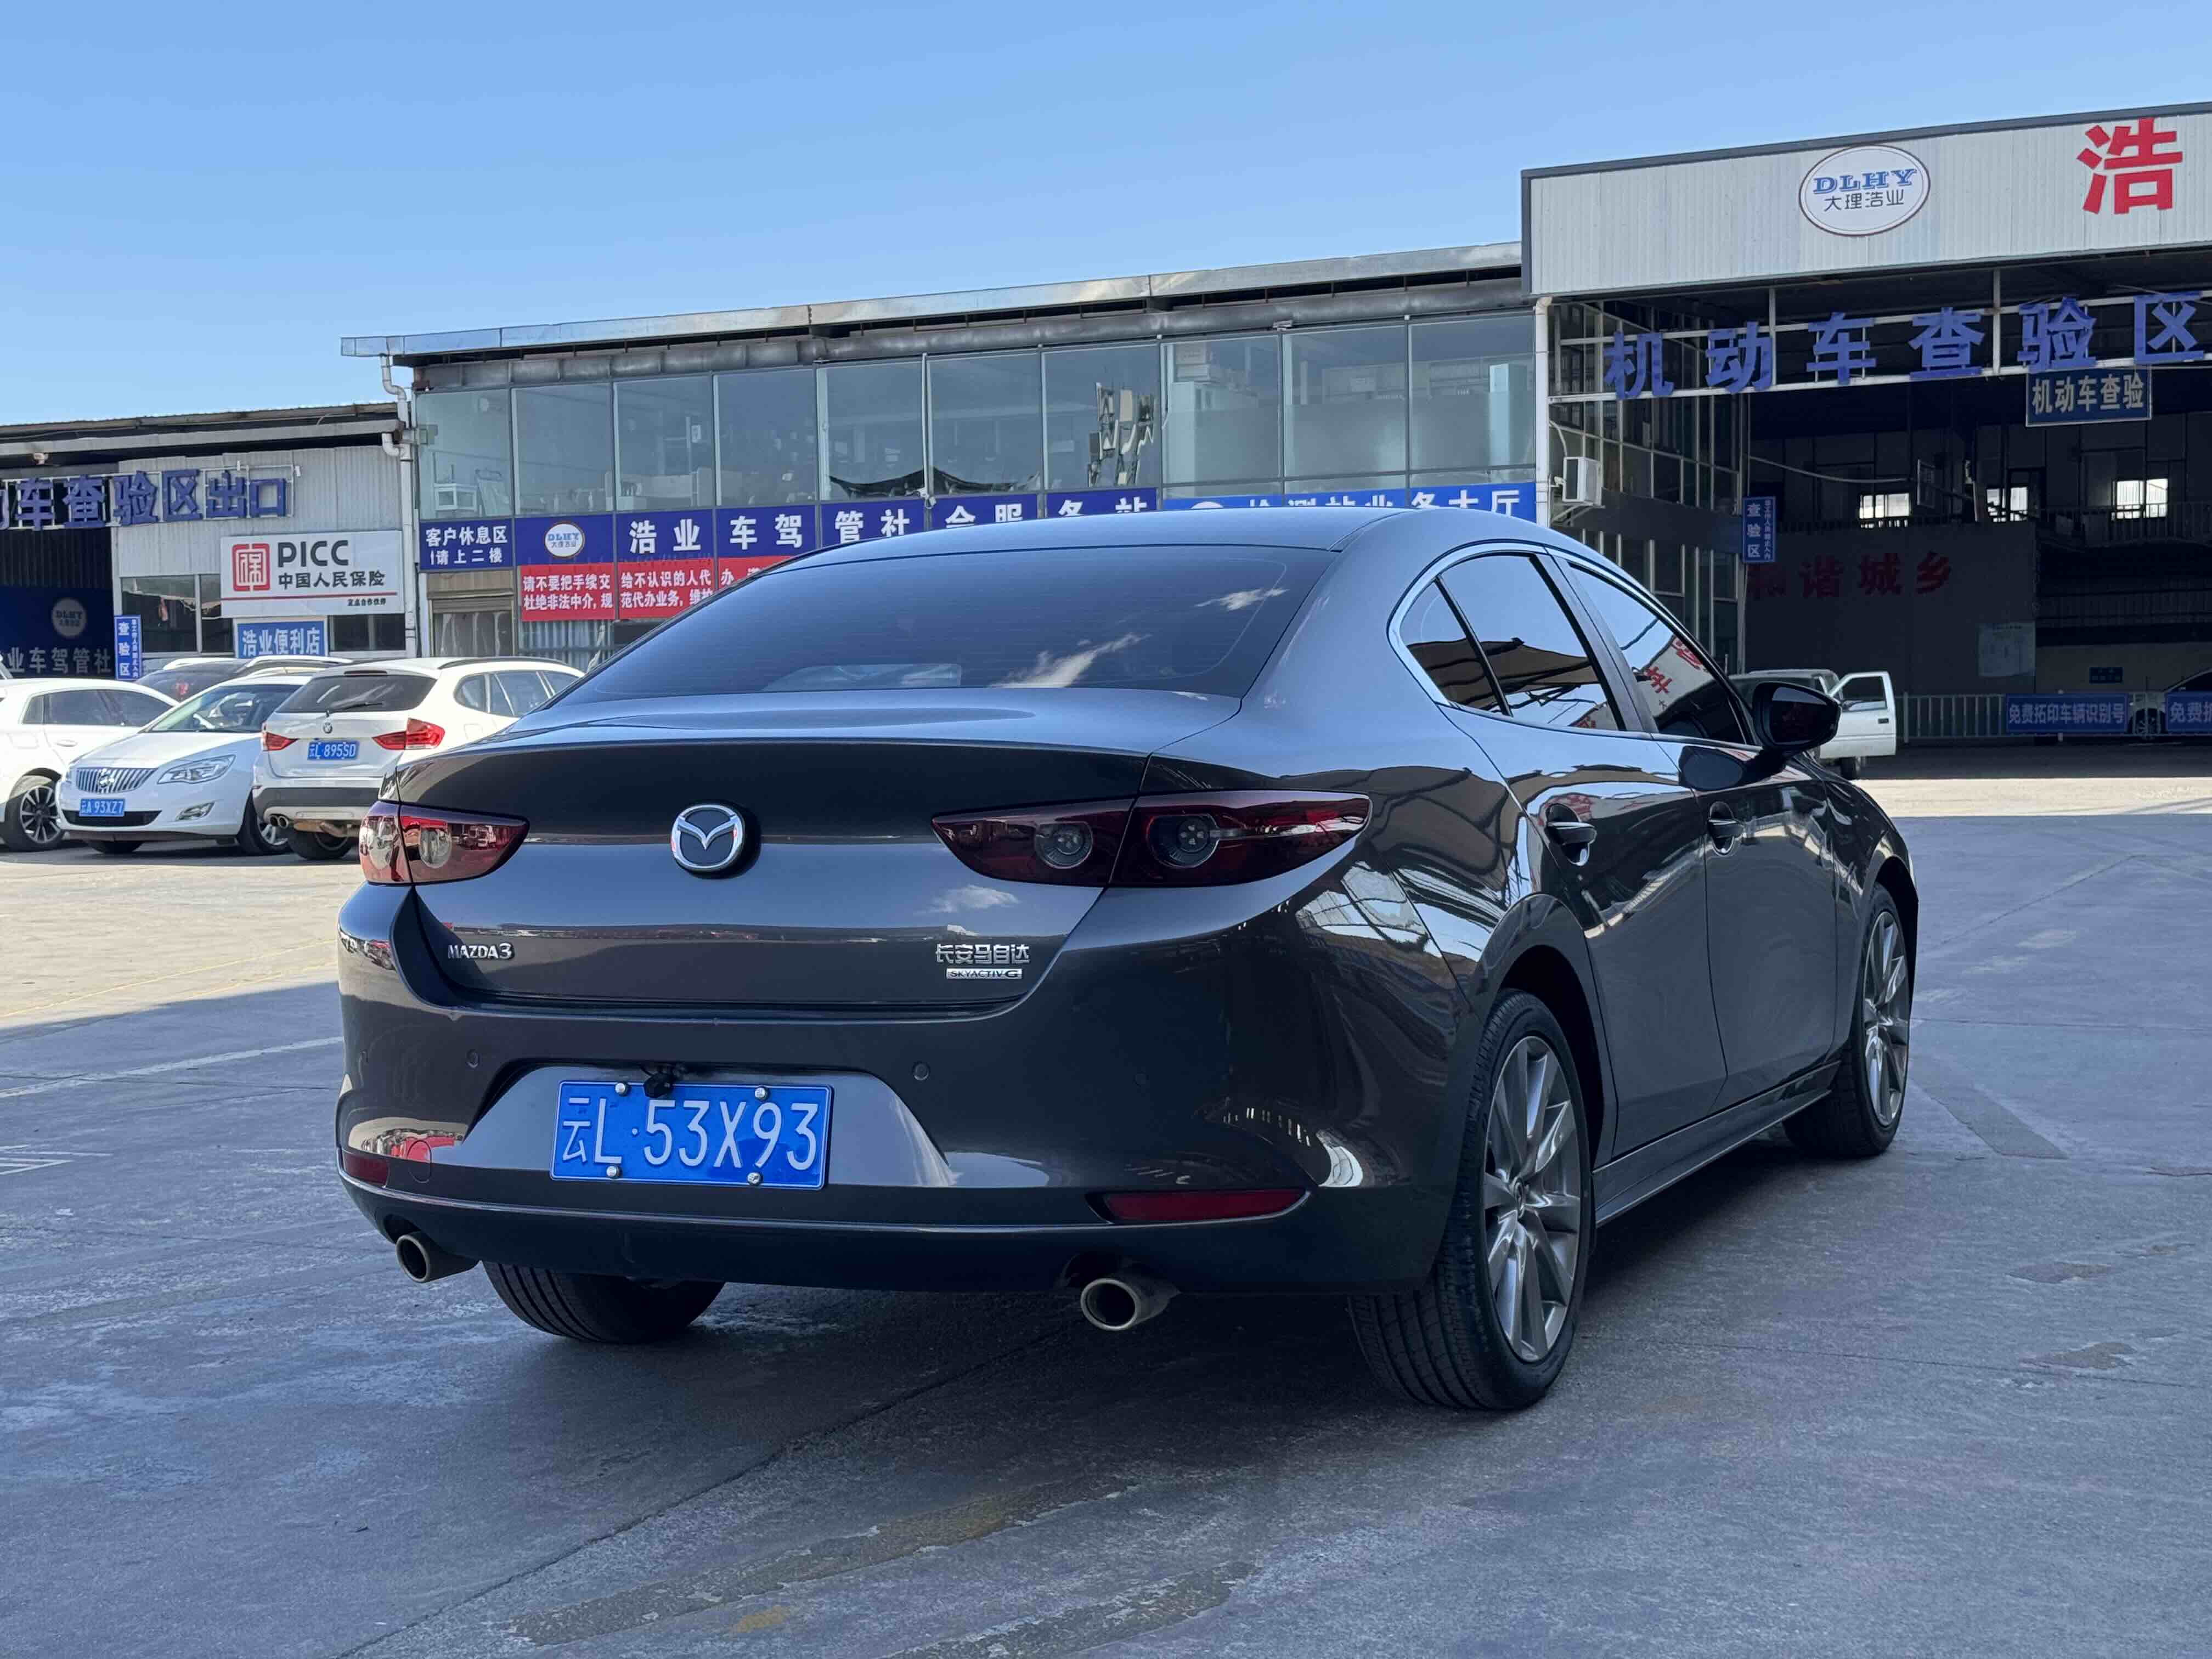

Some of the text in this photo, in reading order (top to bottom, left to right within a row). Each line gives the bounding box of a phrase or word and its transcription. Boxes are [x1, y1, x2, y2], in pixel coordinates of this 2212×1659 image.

[2076, 117, 2183, 215] 浩
[1812, 168, 1917, 194] DLHY
[1824, 188, 1905, 212] 大理浩业
[1604, 291, 2205, 399] 机动车查验区
[2032, 373, 2144, 414] 机动车查验
[425, 525, 508, 548] 客户休息区
[1746, 502, 1761, 558] 查验区
[277, 539, 349, 568] PICC
[435, 547, 503, 566] 请上二楼
[278, 569, 386, 590] 中国人民保险
[523, 573, 611, 592] 请不要把手续交
[620, 569, 712, 589] 给不认识的人代
[118, 621, 131, 676] 查验区
[242, 627, 320, 657] 浩业便利店
[0, 646, 112, 674] 业车驾管社
[448, 942, 513, 960] MAZDA3
[935, 944, 1031, 964] 长安马自达
[561, 1097, 820, 1171] 云L·53X93
